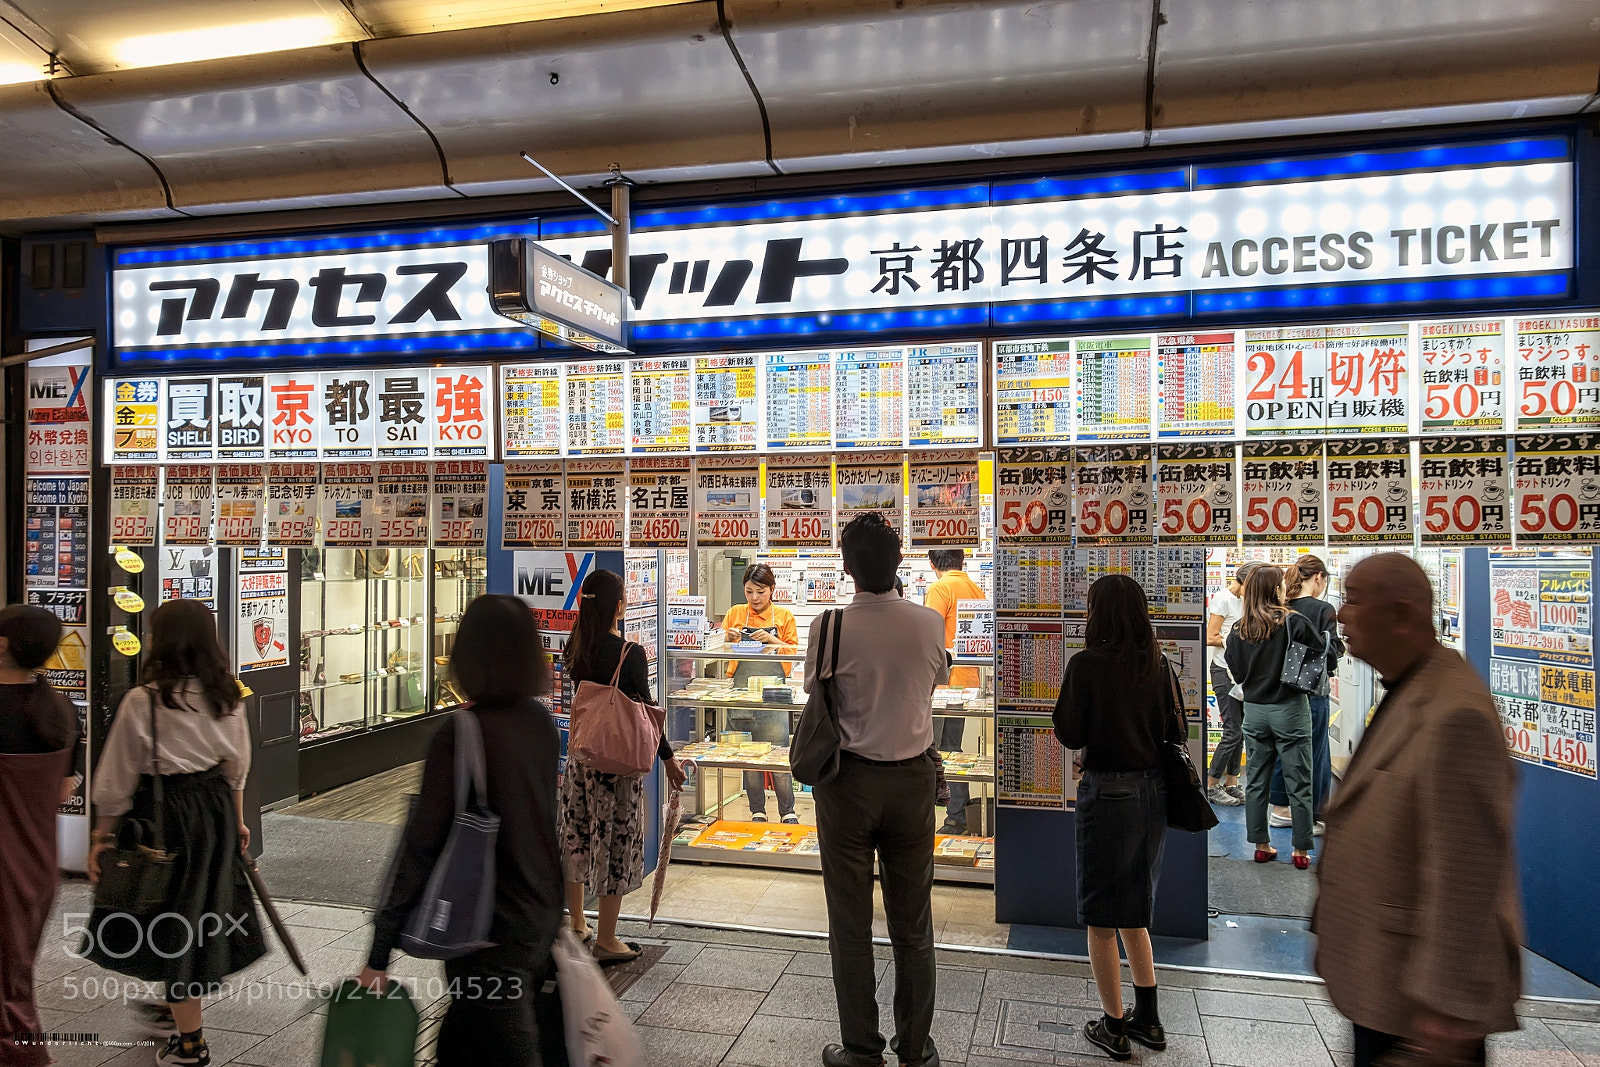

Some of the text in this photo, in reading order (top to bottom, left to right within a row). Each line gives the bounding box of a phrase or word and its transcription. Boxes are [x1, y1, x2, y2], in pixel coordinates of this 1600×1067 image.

[1202, 219, 1560, 278] ACCESS TICKET
[870, 224, 1185, 294] 京都四条店
[539, 280, 619, 326] アクセスチケット
[1423, 338, 1472, 350] まじっすか?
[1519, 334, 1569, 346] まじっすか?
[768, 355, 785, 363] JR
[838, 352, 855, 361] JR
[910, 348, 928, 357] JR
[1423, 347, 1500, 366] マジっす。
[1519, 344, 1599, 362] マジっす。
[1328, 348, 1406, 397] 切符
[1423, 368, 1468, 384] 缶飲料
[1519, 365, 1566, 381] 缶飲料
[117, 382, 157, 401] 金券
[1247, 401, 1324, 420] OPEN
[1328, 399, 1405, 418] 自販機
[168, 424, 482, 446] SHELL BIRD KYO TO SAI KYO
[1000, 446, 1067, 462] マジっす。
[1159, 443, 1232, 458] マジっす。
[1244, 440, 1320, 456] マジっす。
[29, 449, 87, 466] 외화환전
[114, 466, 156, 477] 高価買取
[168, 466, 210, 477] 高価買取
[219, 465, 262, 477] 高価買取
[270, 464, 315, 476] 高価買取
[325, 464, 372, 476] 高価買取
[380, 463, 427, 474] 高価買取
[436, 461, 484, 474] 高価買取
[515, 464, 551, 472] キャンペーン
[577, 462, 614, 470] キャンペーン
[1159, 463, 1232, 482] 缶飲料
[1244, 461, 1319, 481] 缶飲料
[1328, 458, 1406, 480] 缶飲料
[1422, 458, 1503, 479] 缶飲料
[1516, 456, 1600, 476] 缶飲料
[769, 471, 829, 488] 近鉄株主優待券
[999, 466, 1067, 485] 缶飲料
[1078, 465, 1148, 484] 缶飲料
[28, 480, 88, 492] Welcome to Japan
[167, 486, 210, 499] JCB 1000
[270, 485, 315, 499] 記念切手
[1159, 484, 1205, 493] ホットドリンク
[1244, 482, 1292, 492] ホットドリンク
[1328, 481, 1378, 491] ホットドリンク
[1422, 480, 1473, 490] ホットドリンク
[27, 492, 87, 504] Welcome to Kyoto
[506, 489, 561, 511] 東京
[571, 489, 616, 510] 新横浜
[632, 487, 688, 509] 名古屋
[182, 579, 212, 592] 買取
[1540, 579, 1589, 592] アルバイト
[29, 592, 40, 603] 金
[1542, 605, 1577, 625] 1000
[1504, 633, 1563, 650] 0120-72-3916
[1539, 653, 1591, 664] アクセスチケット
[1492, 663, 1538, 696] 市営地下鉄
[1542, 668, 1593, 694] 近鉄電車
[1508, 699, 1539, 722] 京都
[1559, 708, 1595, 734] 名古屋
